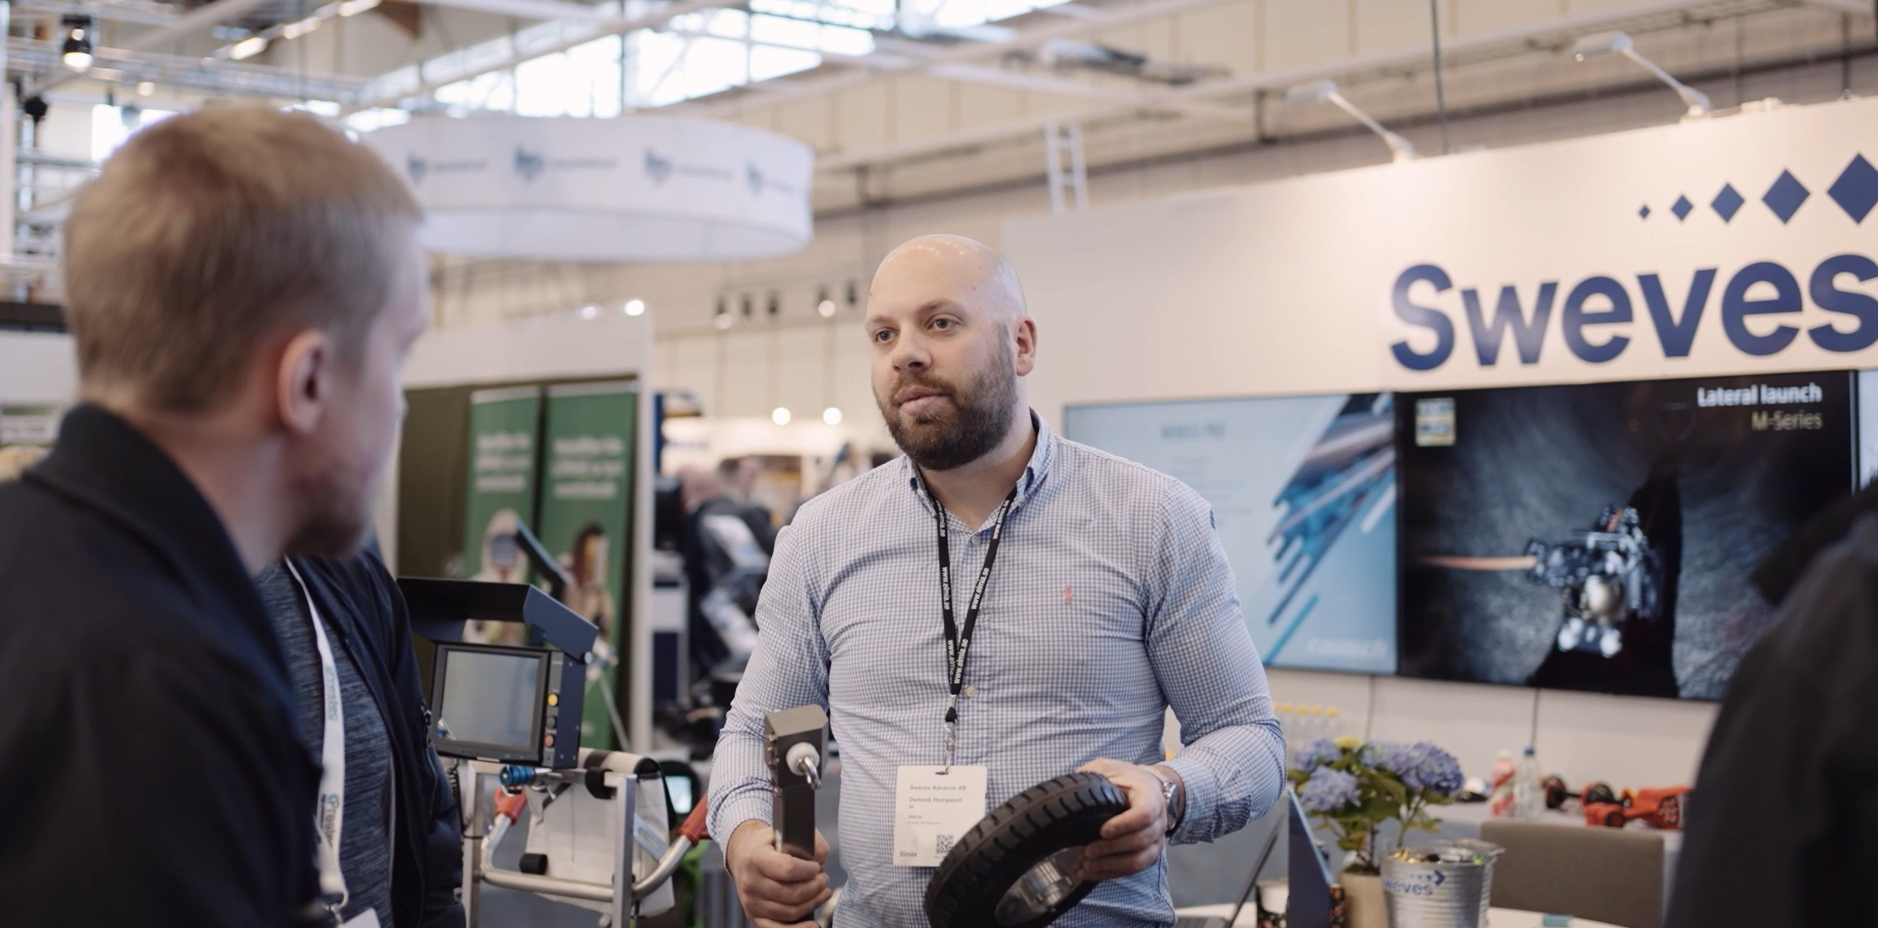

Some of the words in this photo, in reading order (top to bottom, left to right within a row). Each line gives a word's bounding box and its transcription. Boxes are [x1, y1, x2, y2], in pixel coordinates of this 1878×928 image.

[1390, 254, 1878, 371] Sweves
[1697, 384, 1758, 407] Lateral
[1761, 382, 1822, 404] launch
[1751, 410, 1822, 431] M-Series
[942, 566, 951, 610] www.elmia.se
[970, 567, 989, 610] www.elmia.se
[954, 638, 969, 684] www.elmia.se
[1382, 880, 1433, 896] weves
